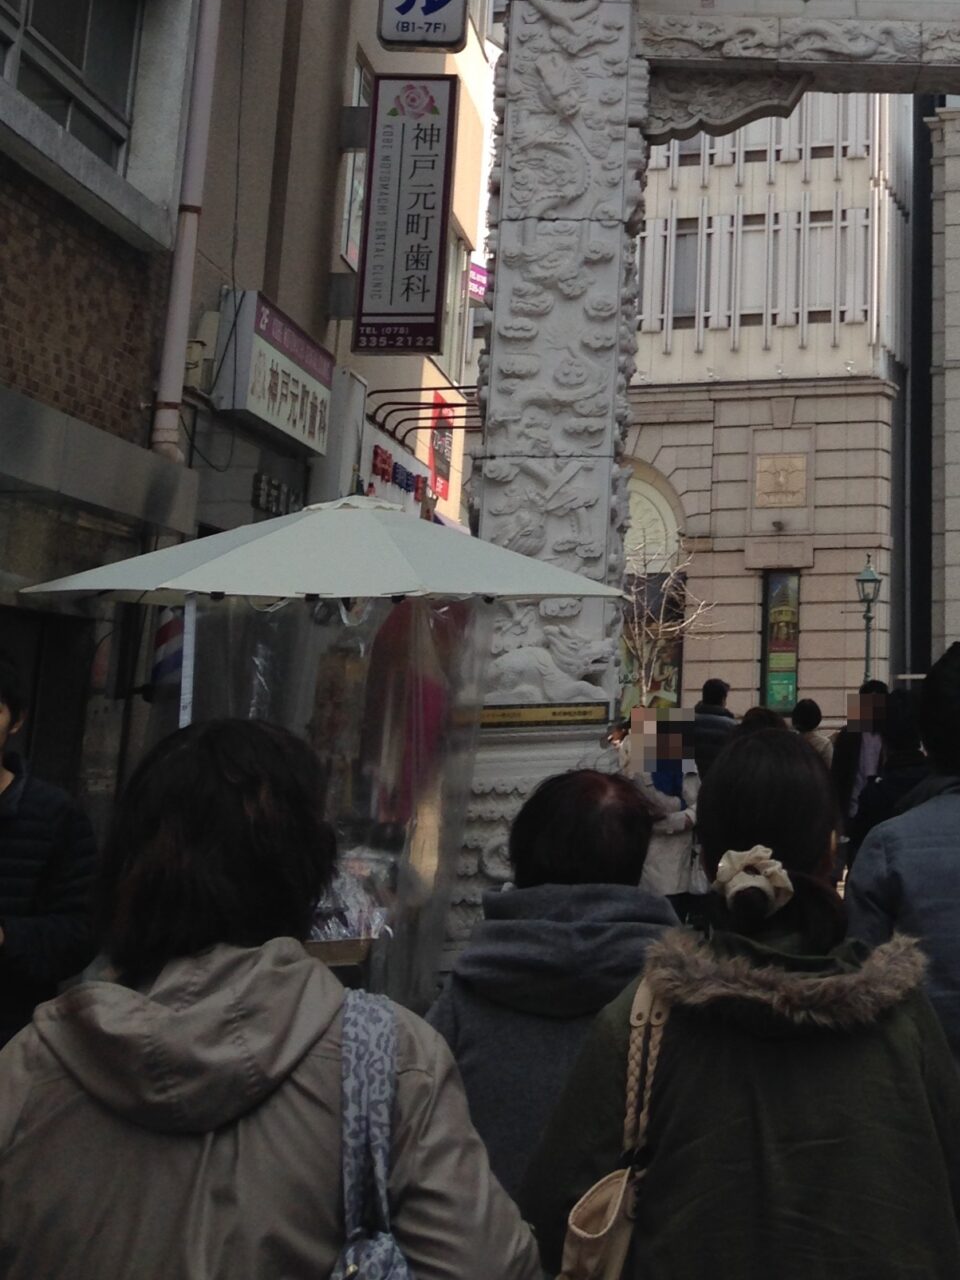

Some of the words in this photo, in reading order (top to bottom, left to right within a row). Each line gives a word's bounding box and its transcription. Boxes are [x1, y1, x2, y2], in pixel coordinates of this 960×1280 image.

[399, 122, 441, 304] 神戸元町歯科
[359, 327, 377, 335] TEL
[358, 336, 435, 347] 335-2122
